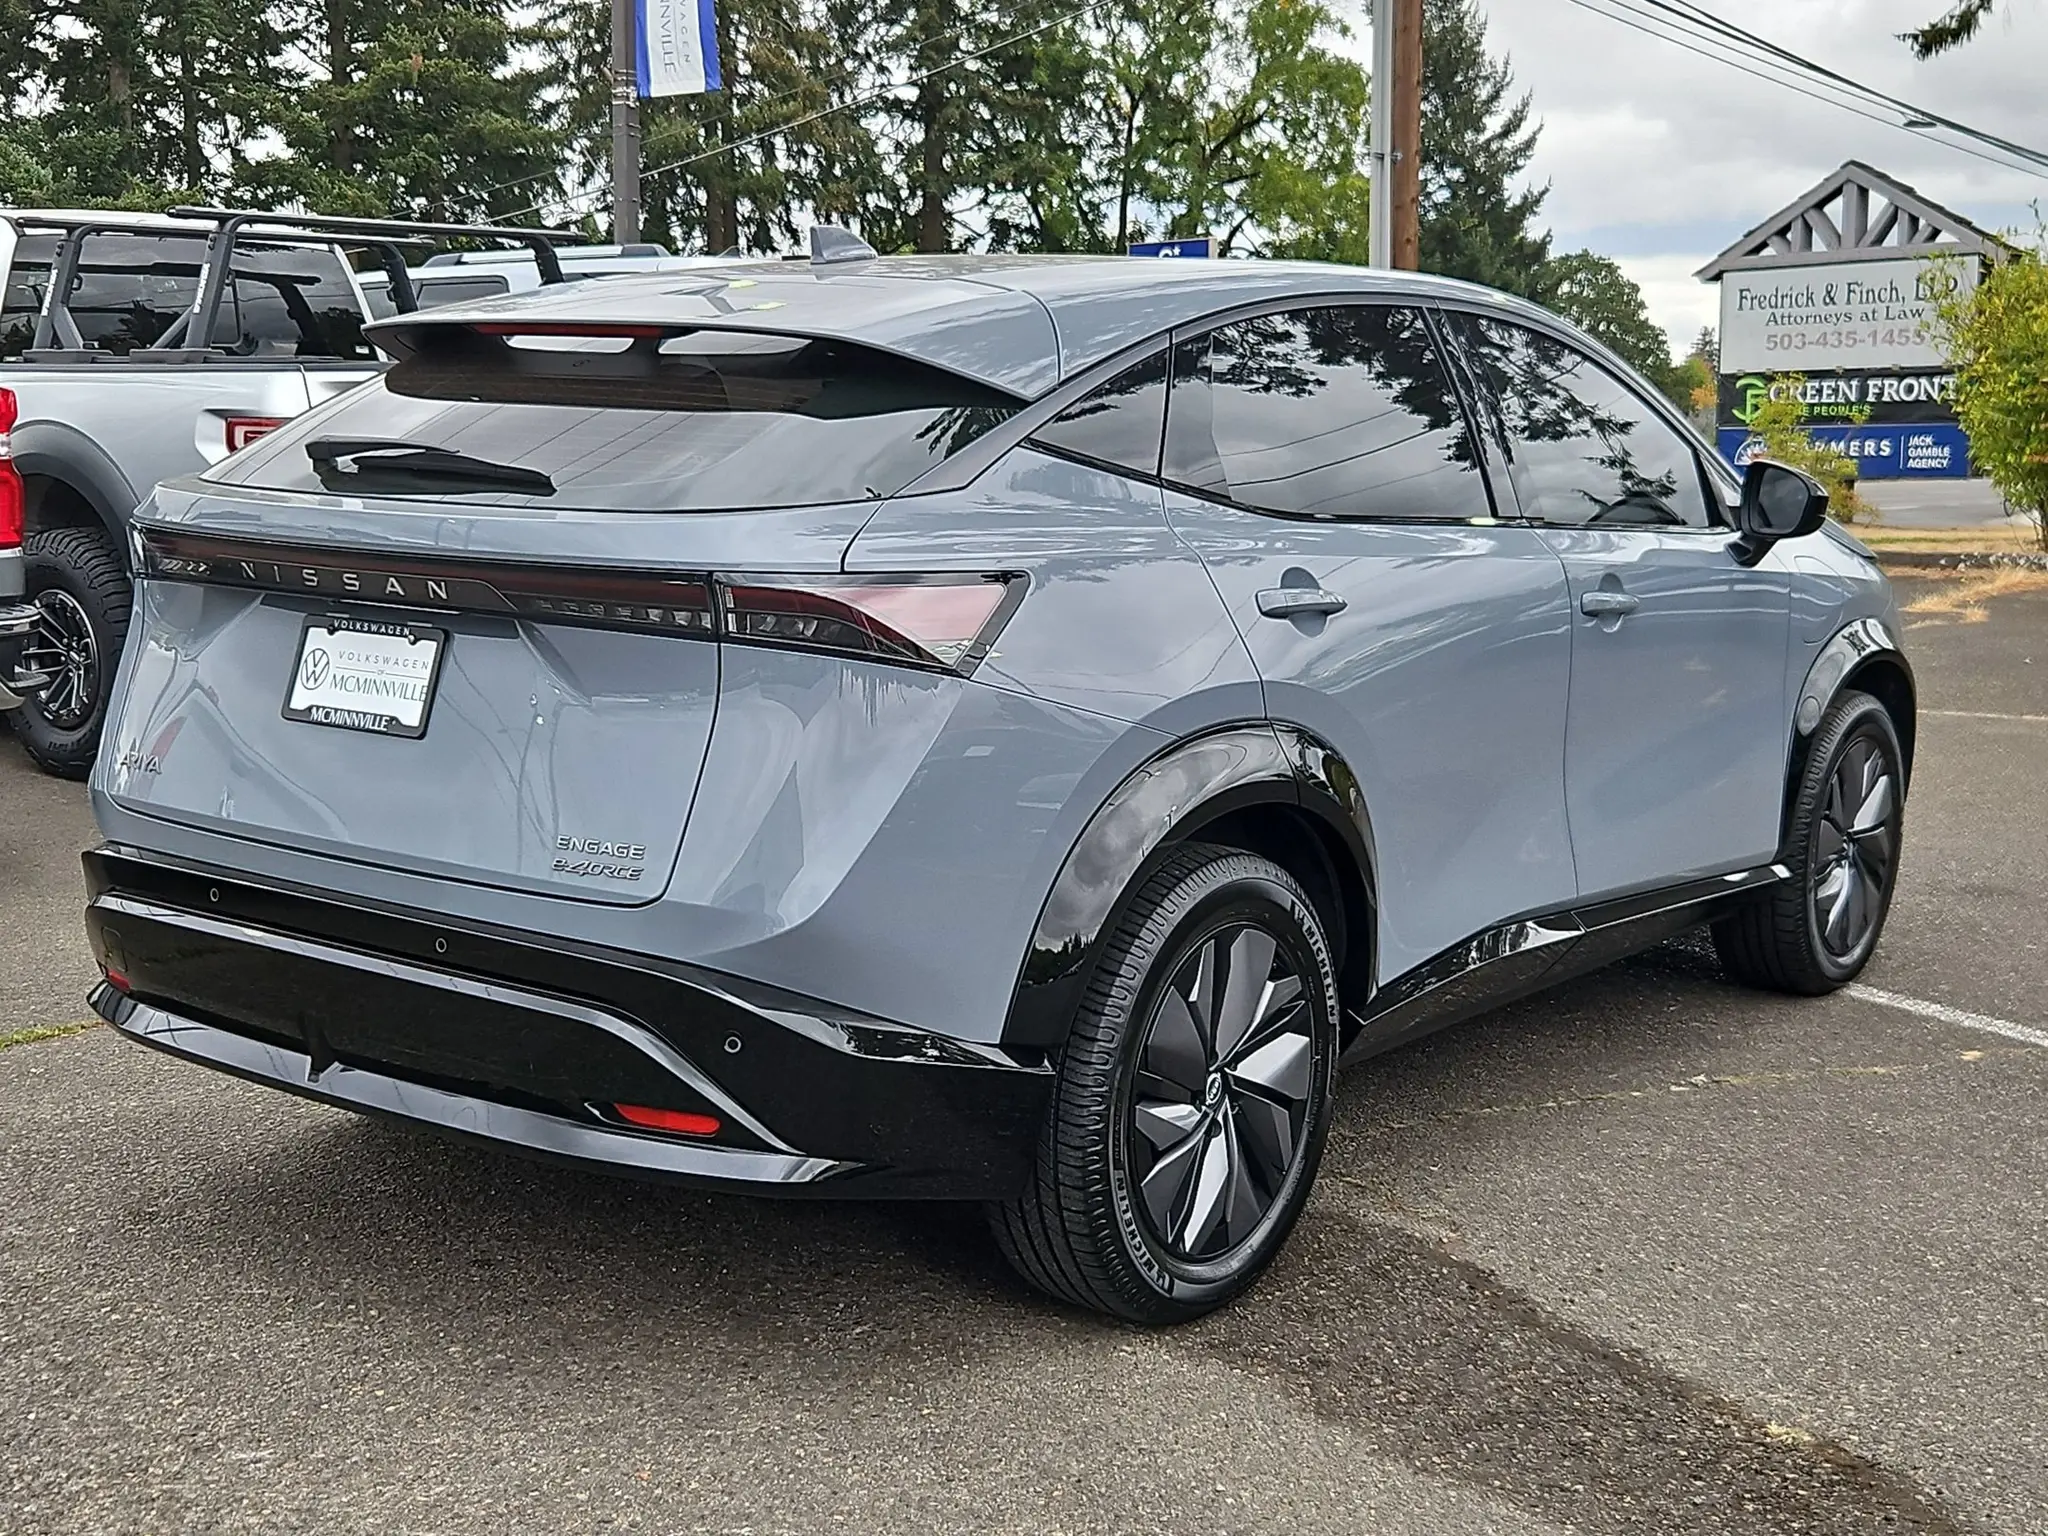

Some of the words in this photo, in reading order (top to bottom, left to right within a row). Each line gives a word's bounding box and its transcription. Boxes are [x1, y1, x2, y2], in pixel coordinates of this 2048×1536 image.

[660, 0, 677, 73] NVILLE
[1737, 282, 1816, 311] Fredrick
[1823, 282, 1839, 307] &
[1845, 278, 1906, 306] Finch,
[1765, 309, 1853, 326] Attorneys
[1860, 308, 1877, 322] at
[1885, 306, 1925, 321] Law
[1765, 328, 1926, 350] 503-435-1455
[1865, 375, 1958, 403] FRONT
[1908, 434, 1934, 447] JACK
[1908, 445, 1951, 458] GAMBLE
[1907, 457, 1951, 469] AGENCY
[240, 561, 449, 600] NISSAN
[333, 619, 411, 637] VOLKSWAGEN
[338, 650, 430, 670] VOLKSWAGEN
[329, 674, 429, 702] MCMINNVILLE
[310, 705, 390, 732] MCMINNVILLE
[556, 834, 646, 860] ENGAGE
[1304, 924, 1336, 1018] MICHELIN
[1116, 1177, 1156, 1274] MICHELIN
